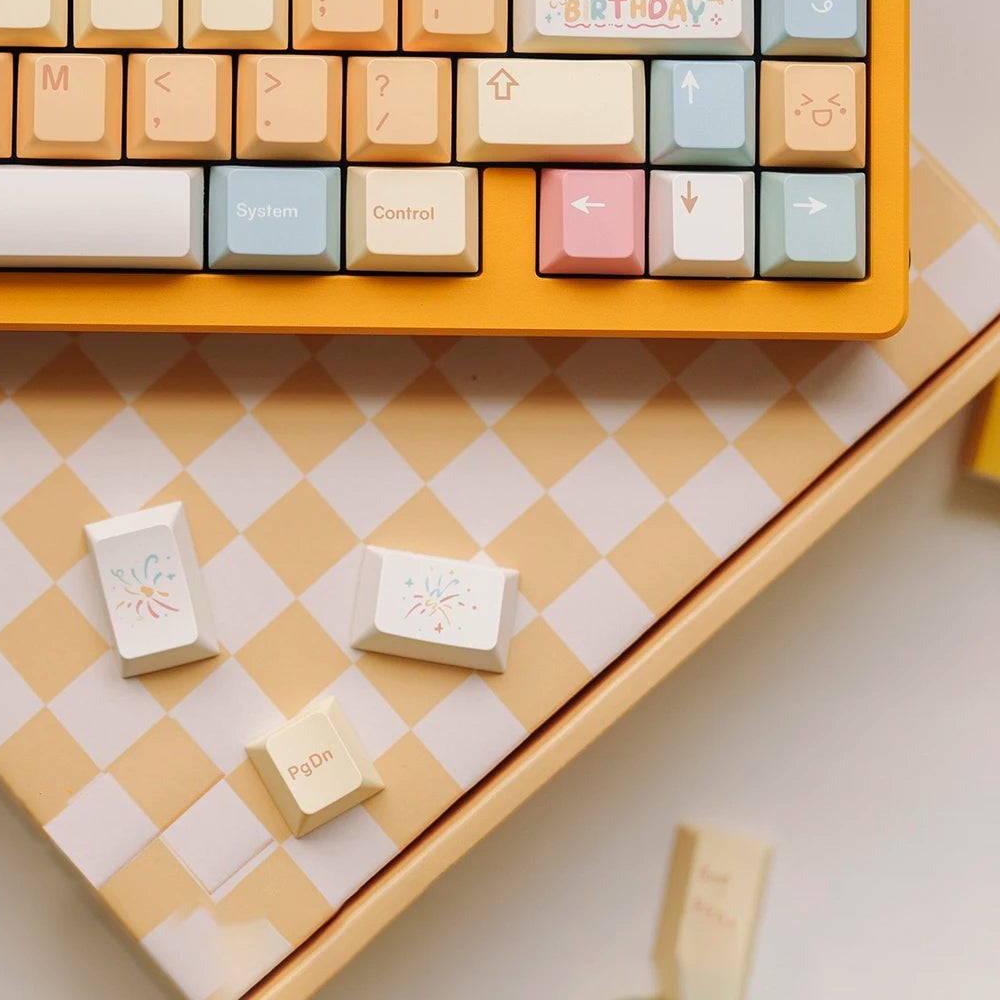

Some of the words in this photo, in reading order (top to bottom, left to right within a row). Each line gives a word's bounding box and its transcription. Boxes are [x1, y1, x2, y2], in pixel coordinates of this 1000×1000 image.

[42, 64, 69, 91] M
[375, 74, 390, 97] ?
[375, 112, 389, 132] /
[236, 202, 298, 220] System
[373, 205, 435, 221] Control
[288, 750, 333, 780] PgDn
